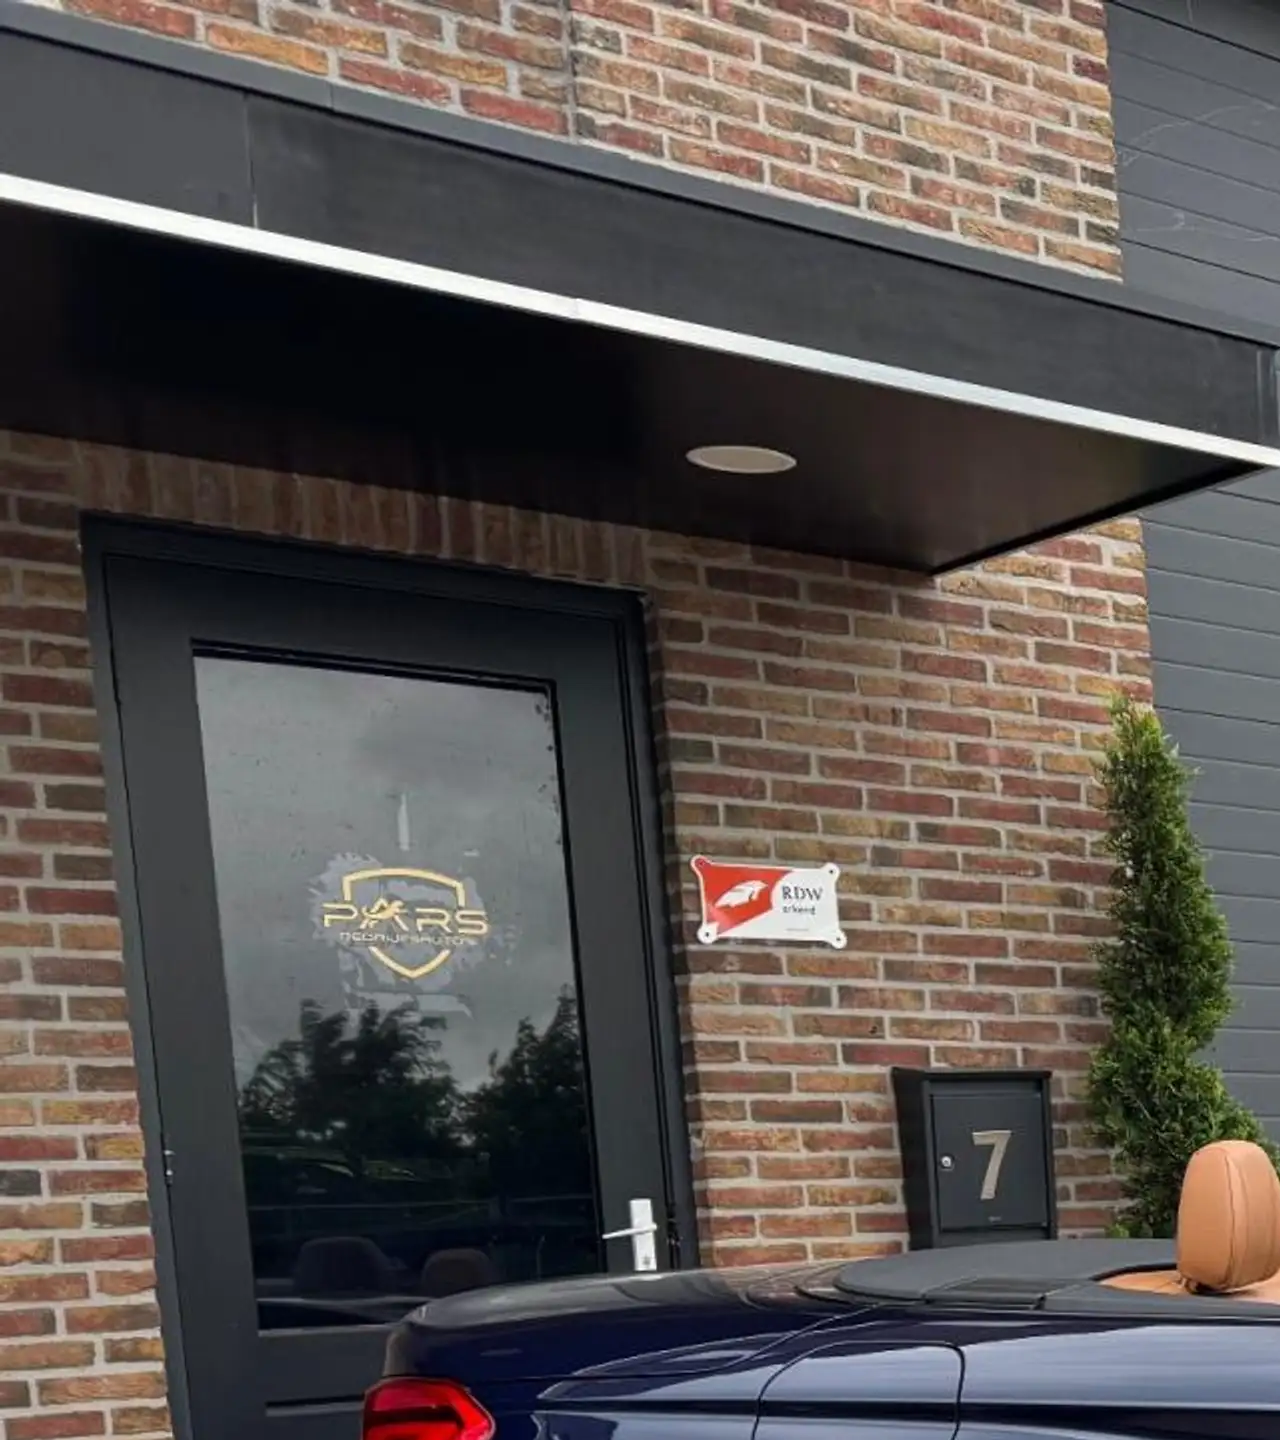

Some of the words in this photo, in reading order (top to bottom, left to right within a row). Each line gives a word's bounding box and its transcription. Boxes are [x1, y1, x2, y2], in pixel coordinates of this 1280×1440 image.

[782, 885, 823, 901] RDW
[322, 897, 489, 935] PARS
[972, 1130, 1012, 1200] 7
